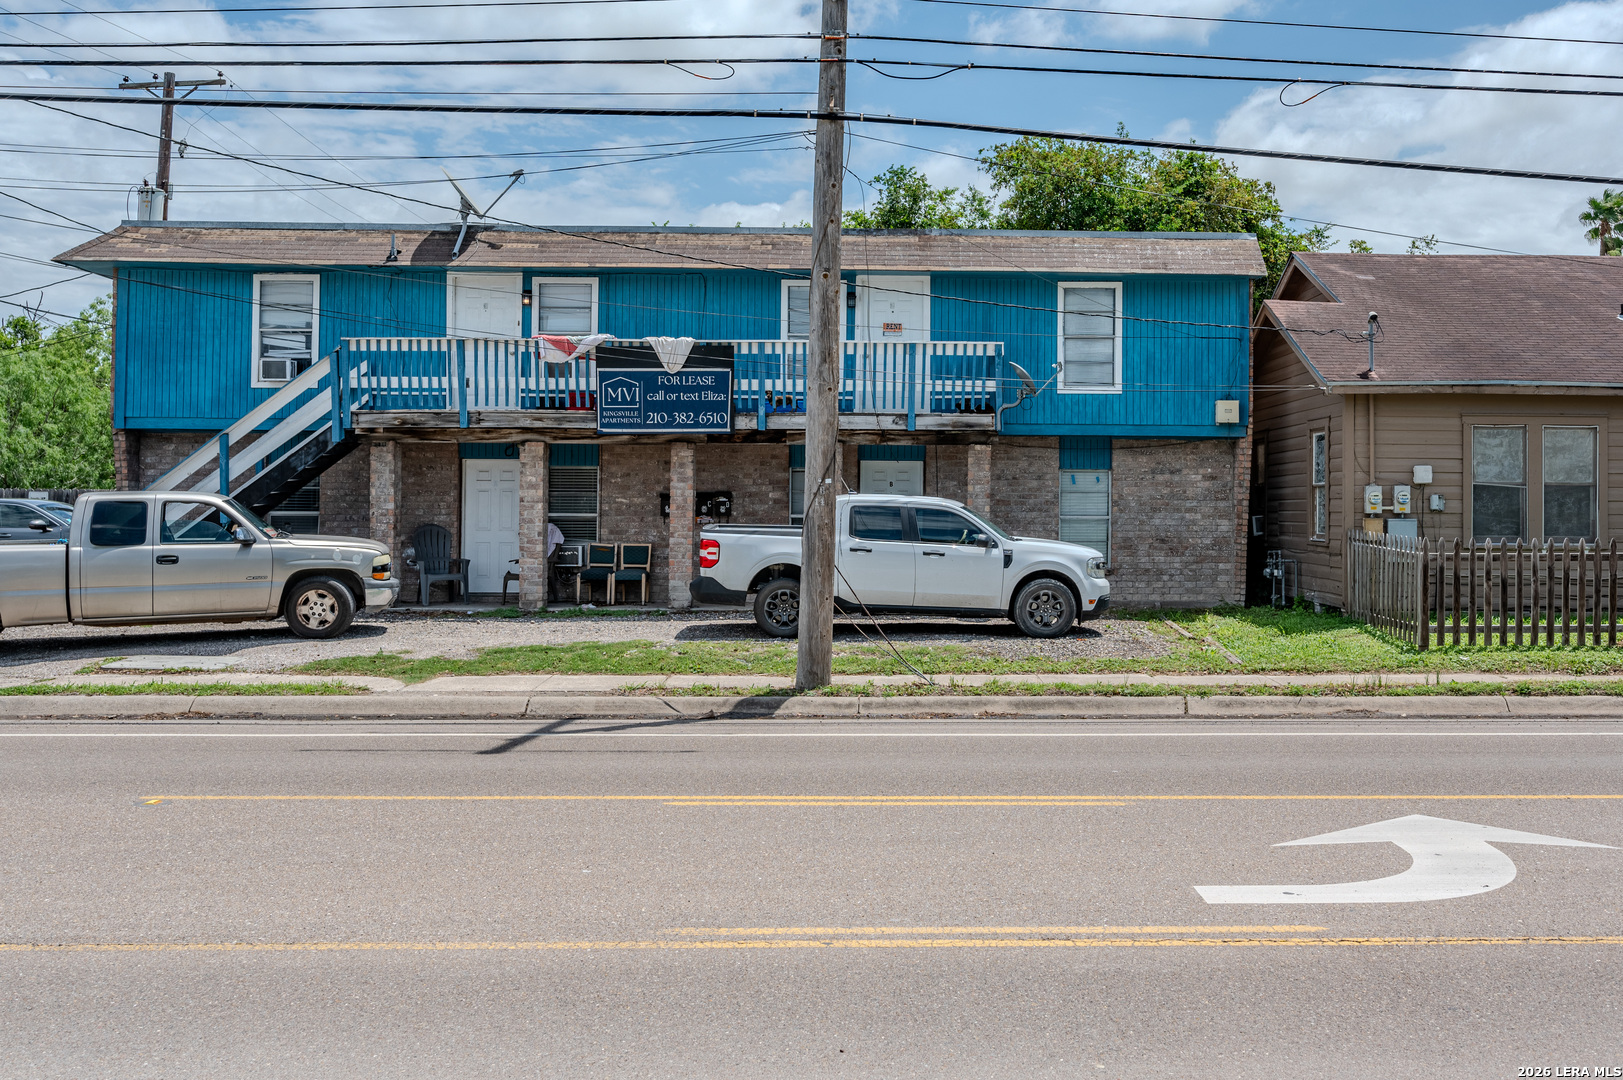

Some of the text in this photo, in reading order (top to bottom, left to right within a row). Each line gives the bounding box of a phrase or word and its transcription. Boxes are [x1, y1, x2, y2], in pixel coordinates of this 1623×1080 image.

[658, 375, 716, 386] FOR LEASE
[646, 390, 727, 401] call or text Eliza:
[646, 411, 727, 426] 210-382-6510
